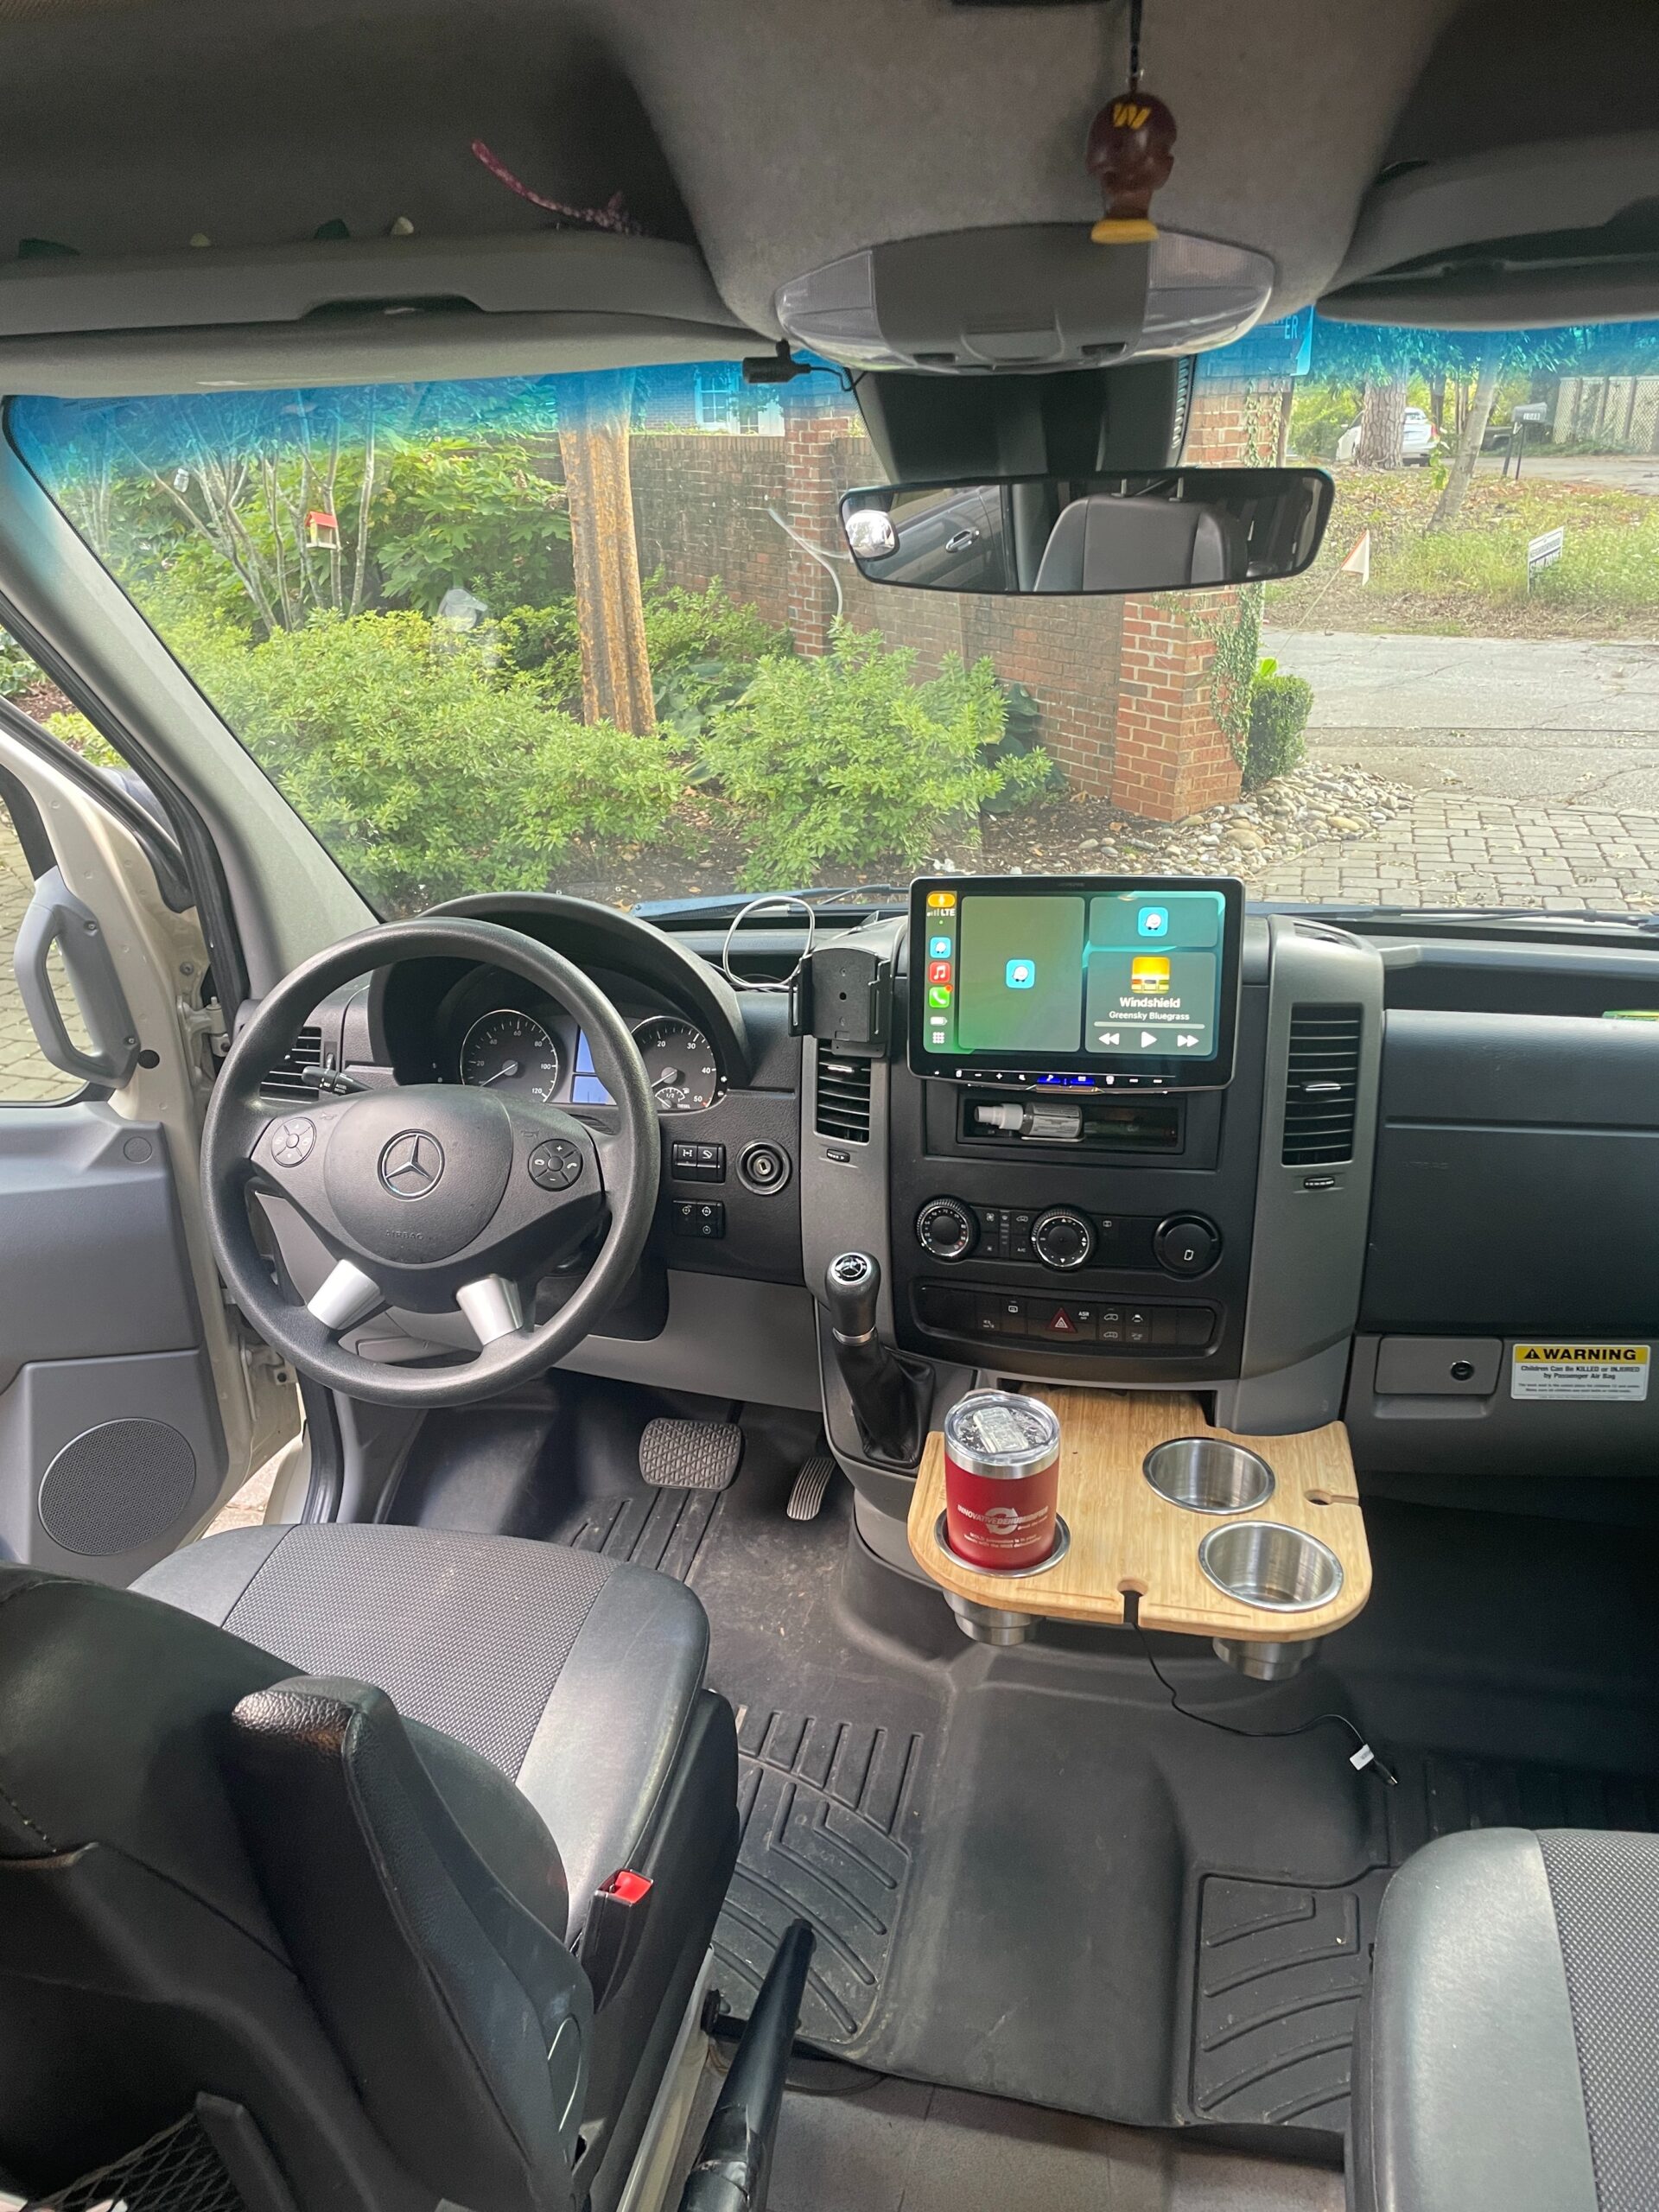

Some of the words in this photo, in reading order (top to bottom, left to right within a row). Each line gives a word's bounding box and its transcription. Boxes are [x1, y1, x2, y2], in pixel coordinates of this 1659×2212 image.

[1119, 996, 1181, 1008] Windshield
[1109, 1010, 1147, 1021] Greensky
[1148, 1012, 1191, 1021] Bluegrass
[1542, 1348, 1637, 1361] WARNING
